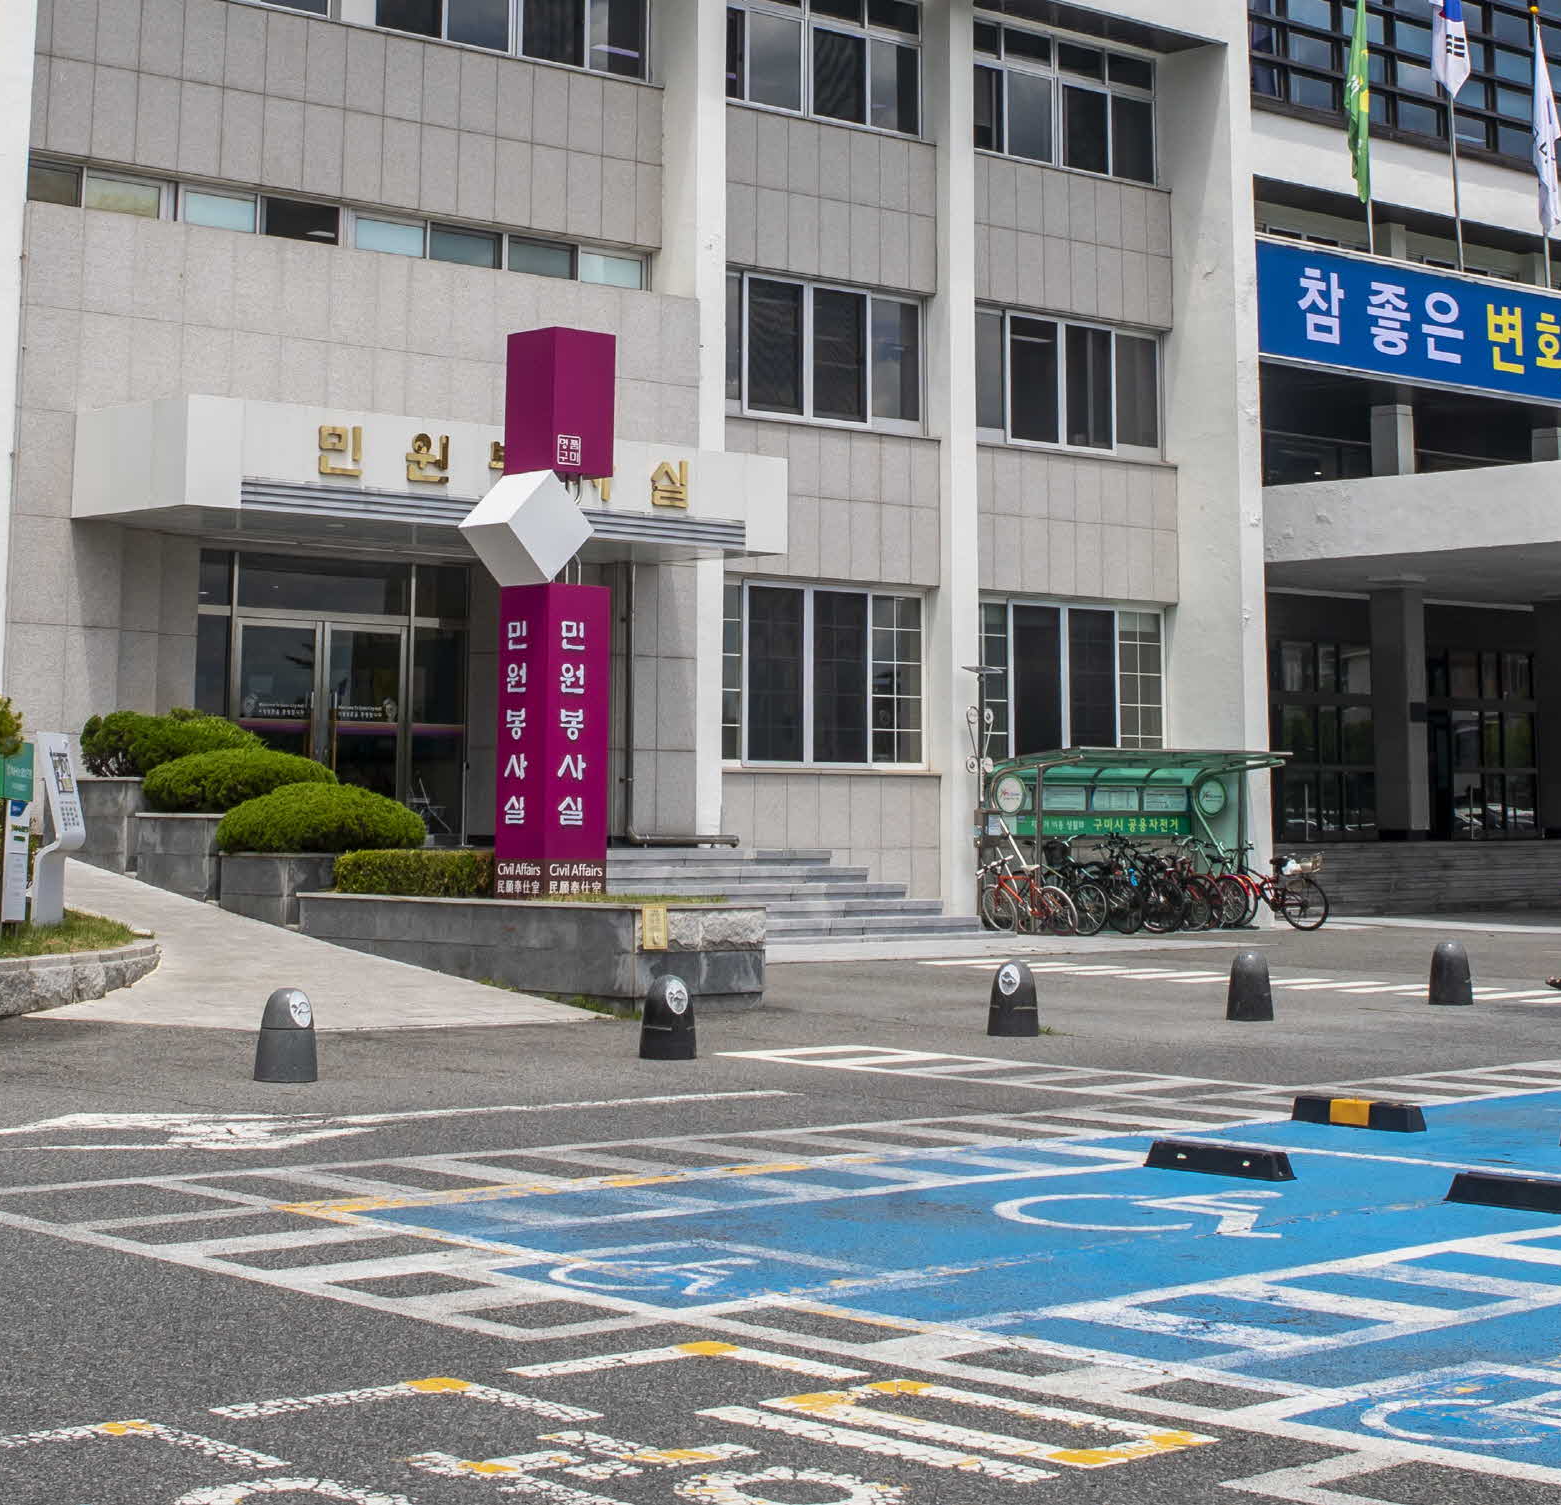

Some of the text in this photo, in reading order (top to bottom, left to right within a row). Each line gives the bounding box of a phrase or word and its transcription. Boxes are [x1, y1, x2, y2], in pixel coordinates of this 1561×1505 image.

[1298, 267, 1344, 345] 참
[1367, 281, 1464, 364] 좋은
[318, 424, 689, 509] 민원실
[560, 451, 579, 463] 구미
[504, 620, 528, 825] 민원봉사실
[557, 620, 586, 826] 민원봉사실
[1093, 819, 1124, 831] 구미시
[1128, 819, 1179, 832] 공용자전거
[498, 863, 541, 876] Civil Affairs
[550, 863, 603, 877] Civil Affairs
